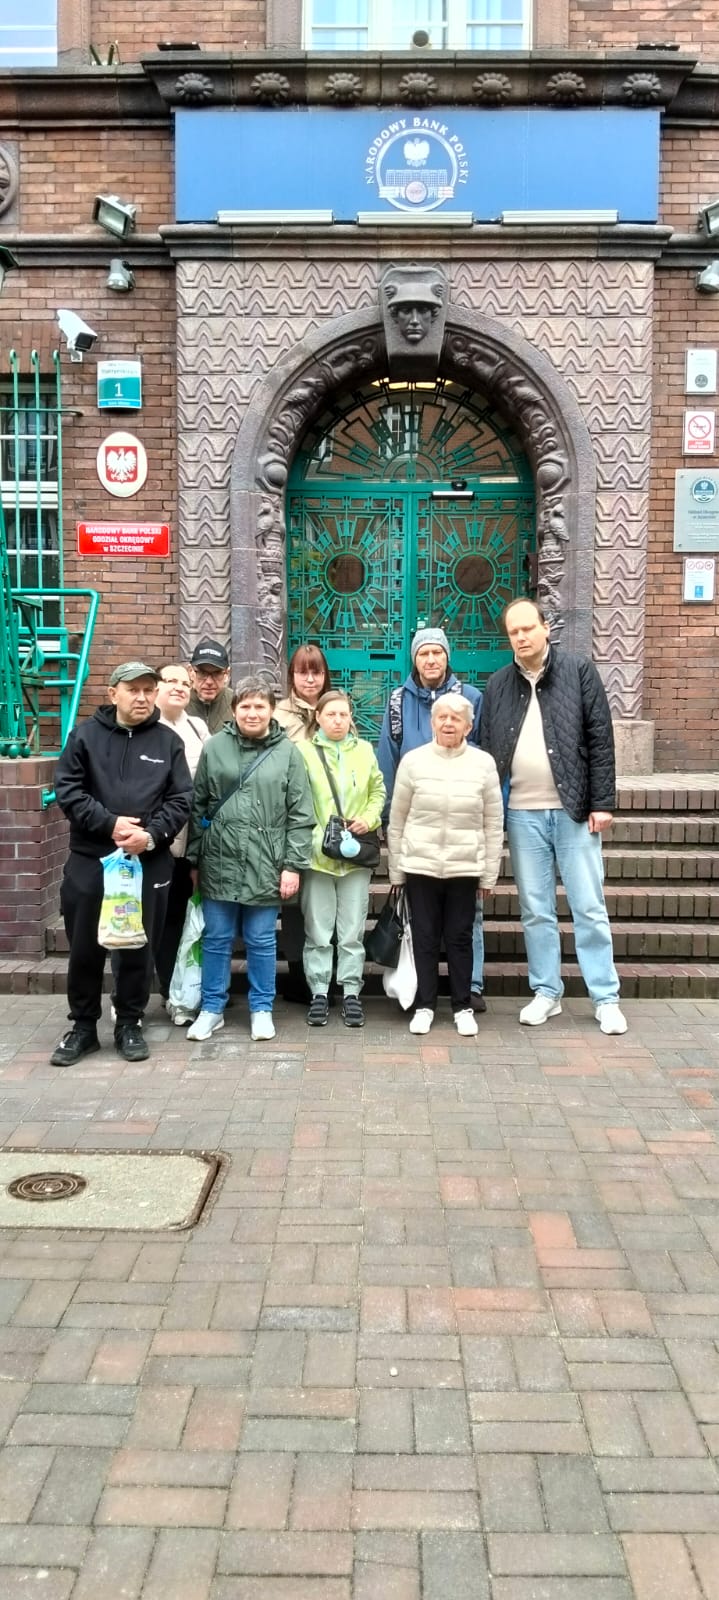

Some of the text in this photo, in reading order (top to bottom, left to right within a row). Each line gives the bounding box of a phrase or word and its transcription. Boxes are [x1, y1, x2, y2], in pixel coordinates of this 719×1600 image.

[365, 117, 470, 185] NARODOWY BANK POLSKI
[114, 382, 124, 397] 1
[119, 536, 154, 544] OKRĘGOWY
